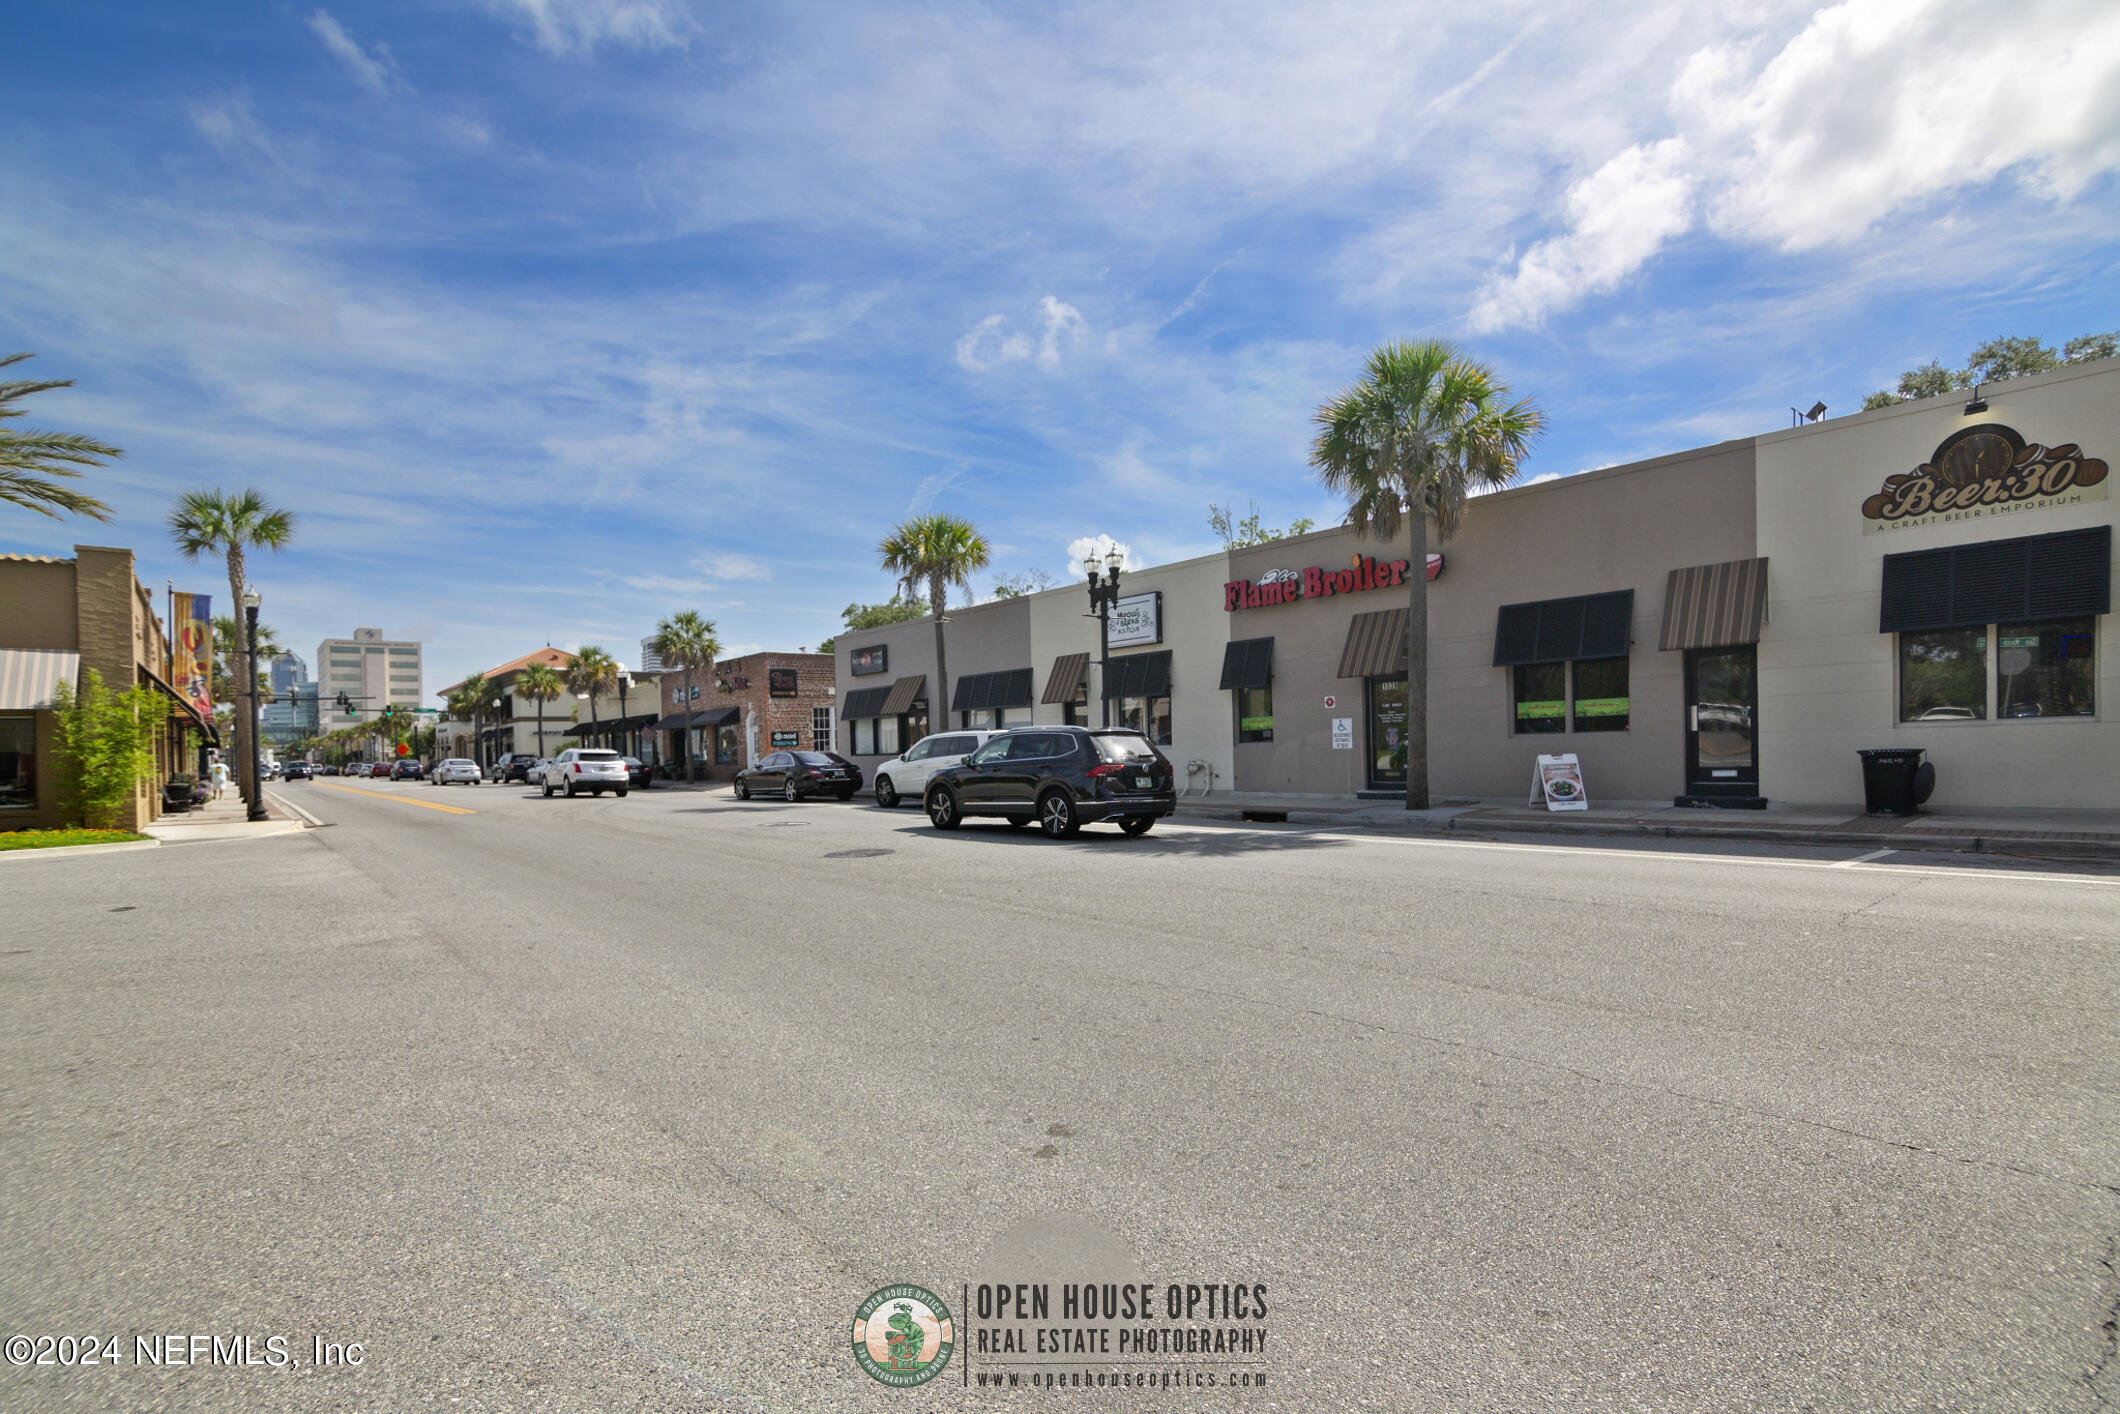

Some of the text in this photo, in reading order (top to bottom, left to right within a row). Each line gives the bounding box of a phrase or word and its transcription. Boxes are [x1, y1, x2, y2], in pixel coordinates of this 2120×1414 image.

[1877, 495, 2082, 532] A CRAFT BEER EMPORIUM
[1883, 459, 2076, 518] Beer:30
[1224, 553, 1409, 612] Flame Broiler
